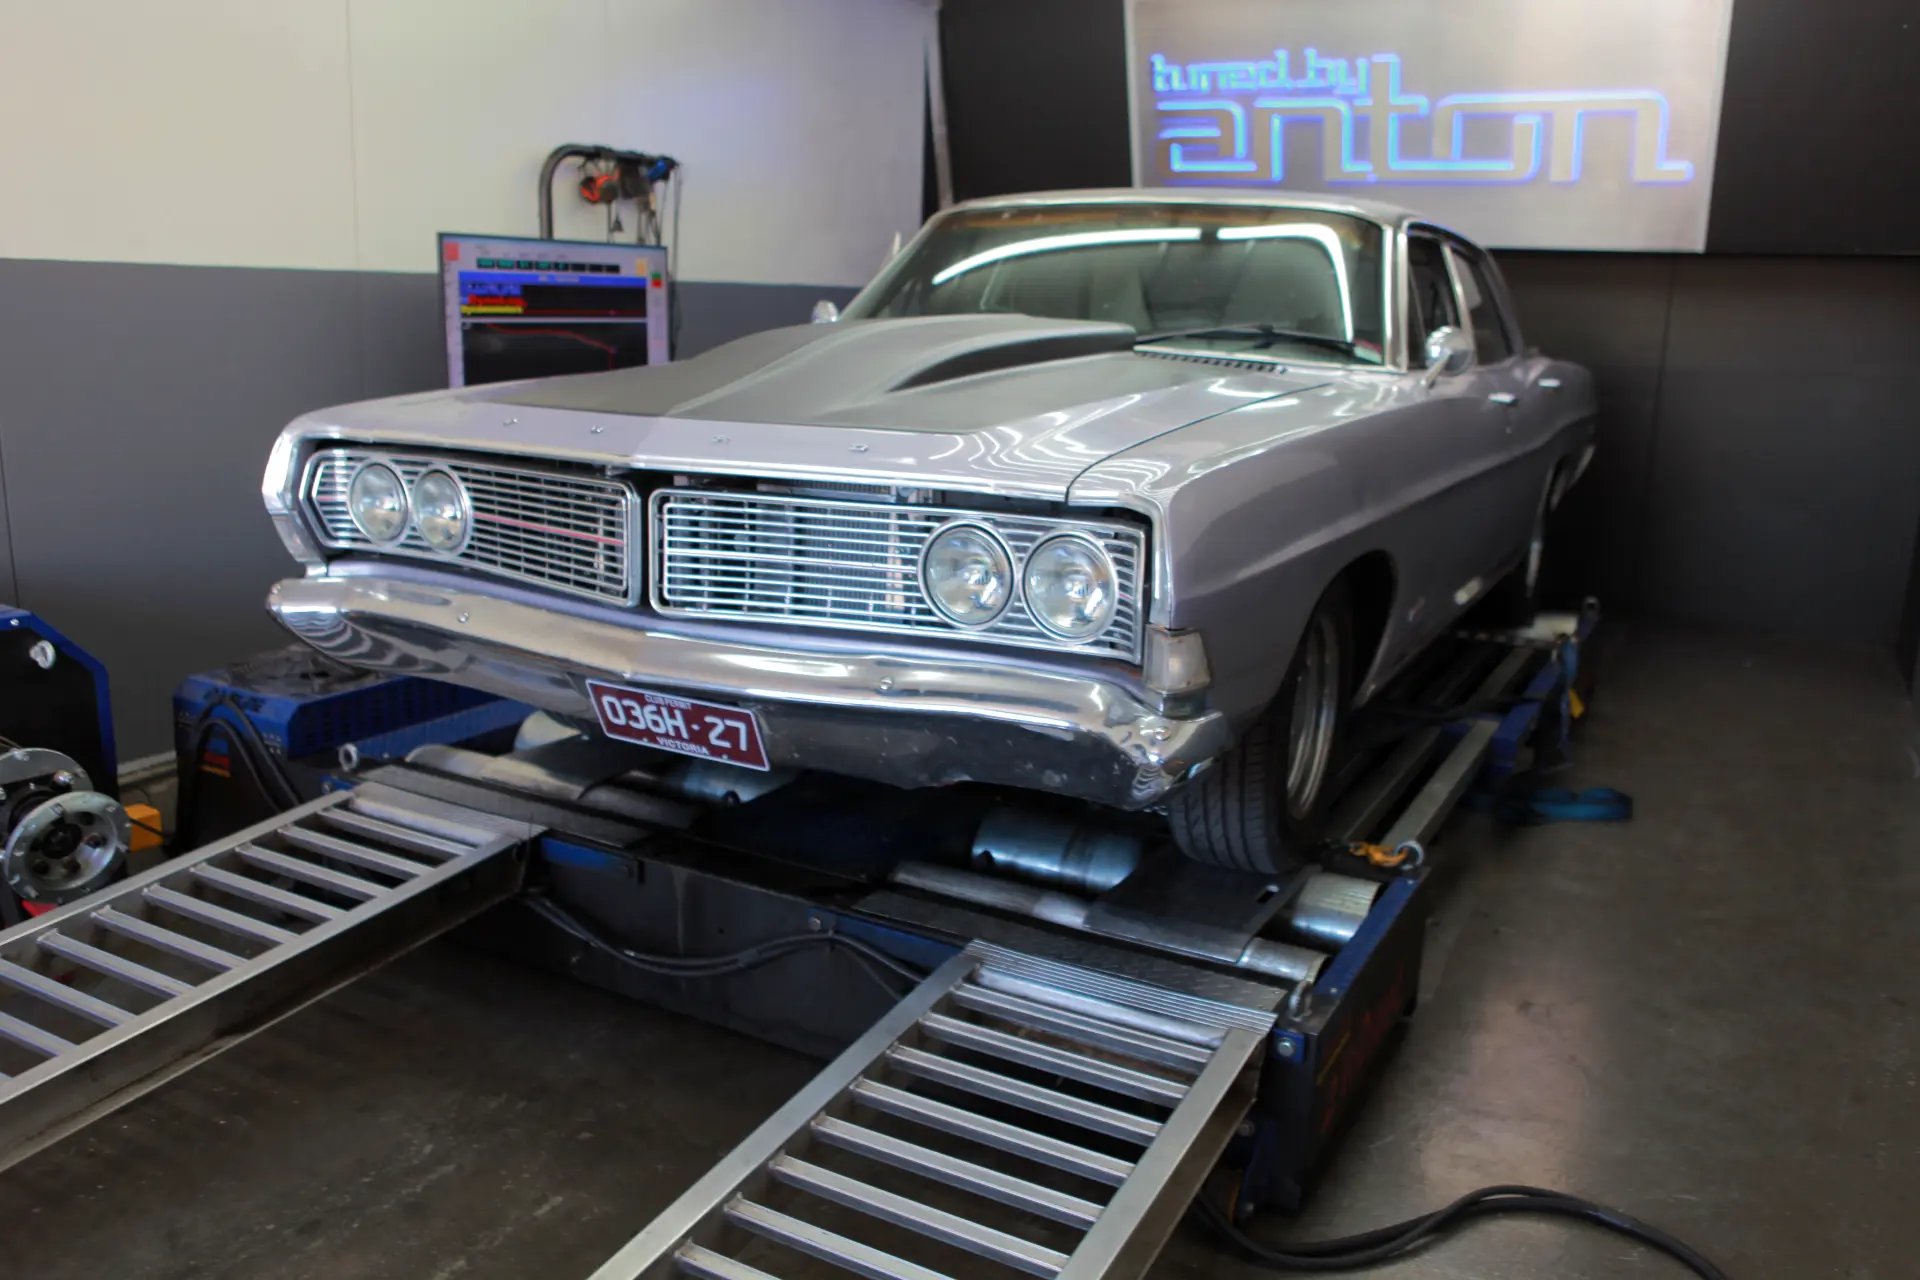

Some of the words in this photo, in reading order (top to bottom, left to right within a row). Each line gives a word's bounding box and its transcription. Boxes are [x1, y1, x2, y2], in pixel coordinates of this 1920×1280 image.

[1151, 48, 1293, 93] tuned
[1300, 47, 1369, 96] by
[1156, 53, 1694, 184] anton
[656, 736, 710, 756] VICTORIA
